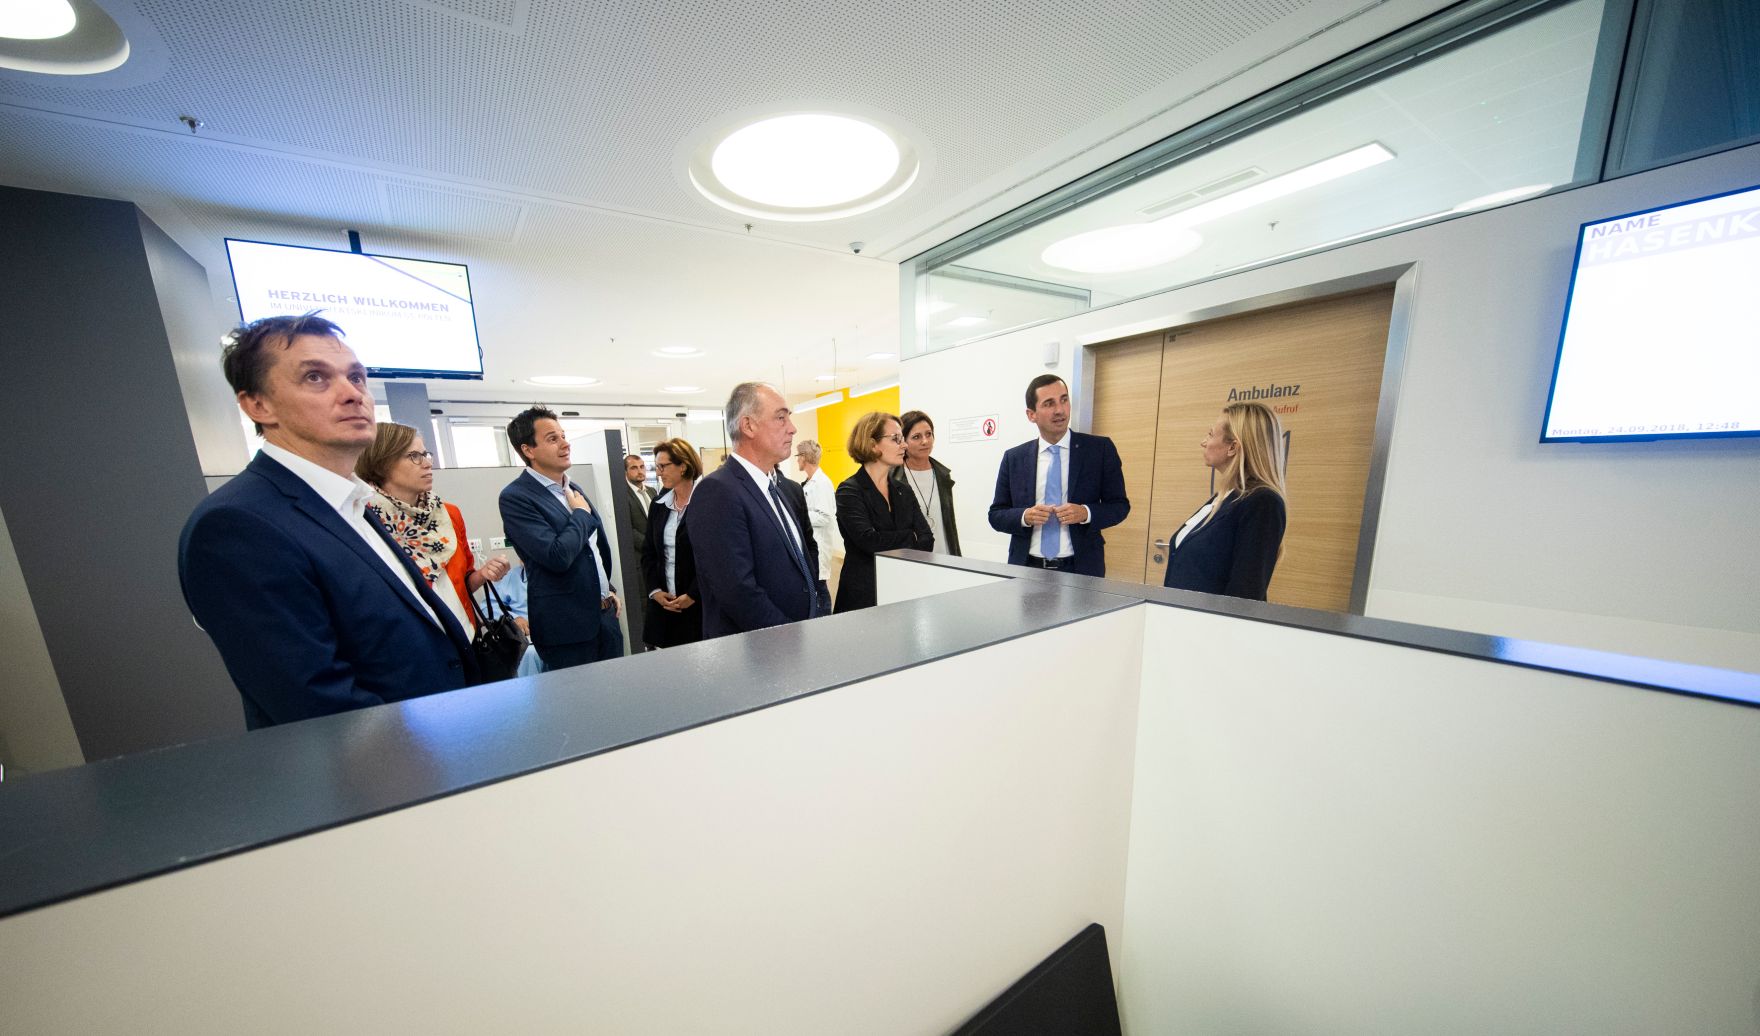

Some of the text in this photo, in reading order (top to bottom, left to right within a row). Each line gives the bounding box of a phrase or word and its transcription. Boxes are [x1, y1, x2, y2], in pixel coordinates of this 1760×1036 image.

[1587, 210, 1760, 262] HASENK
[1591, 214, 1662, 239] NAME
[268, 289, 450, 312] HERZLICH WILLKOMMEN
[270, 302, 282, 310] IM
[1227, 384, 1301, 402] Ambulanz
[1551, 420, 1741, 437] Montag, 24.09.2018, 12:48
